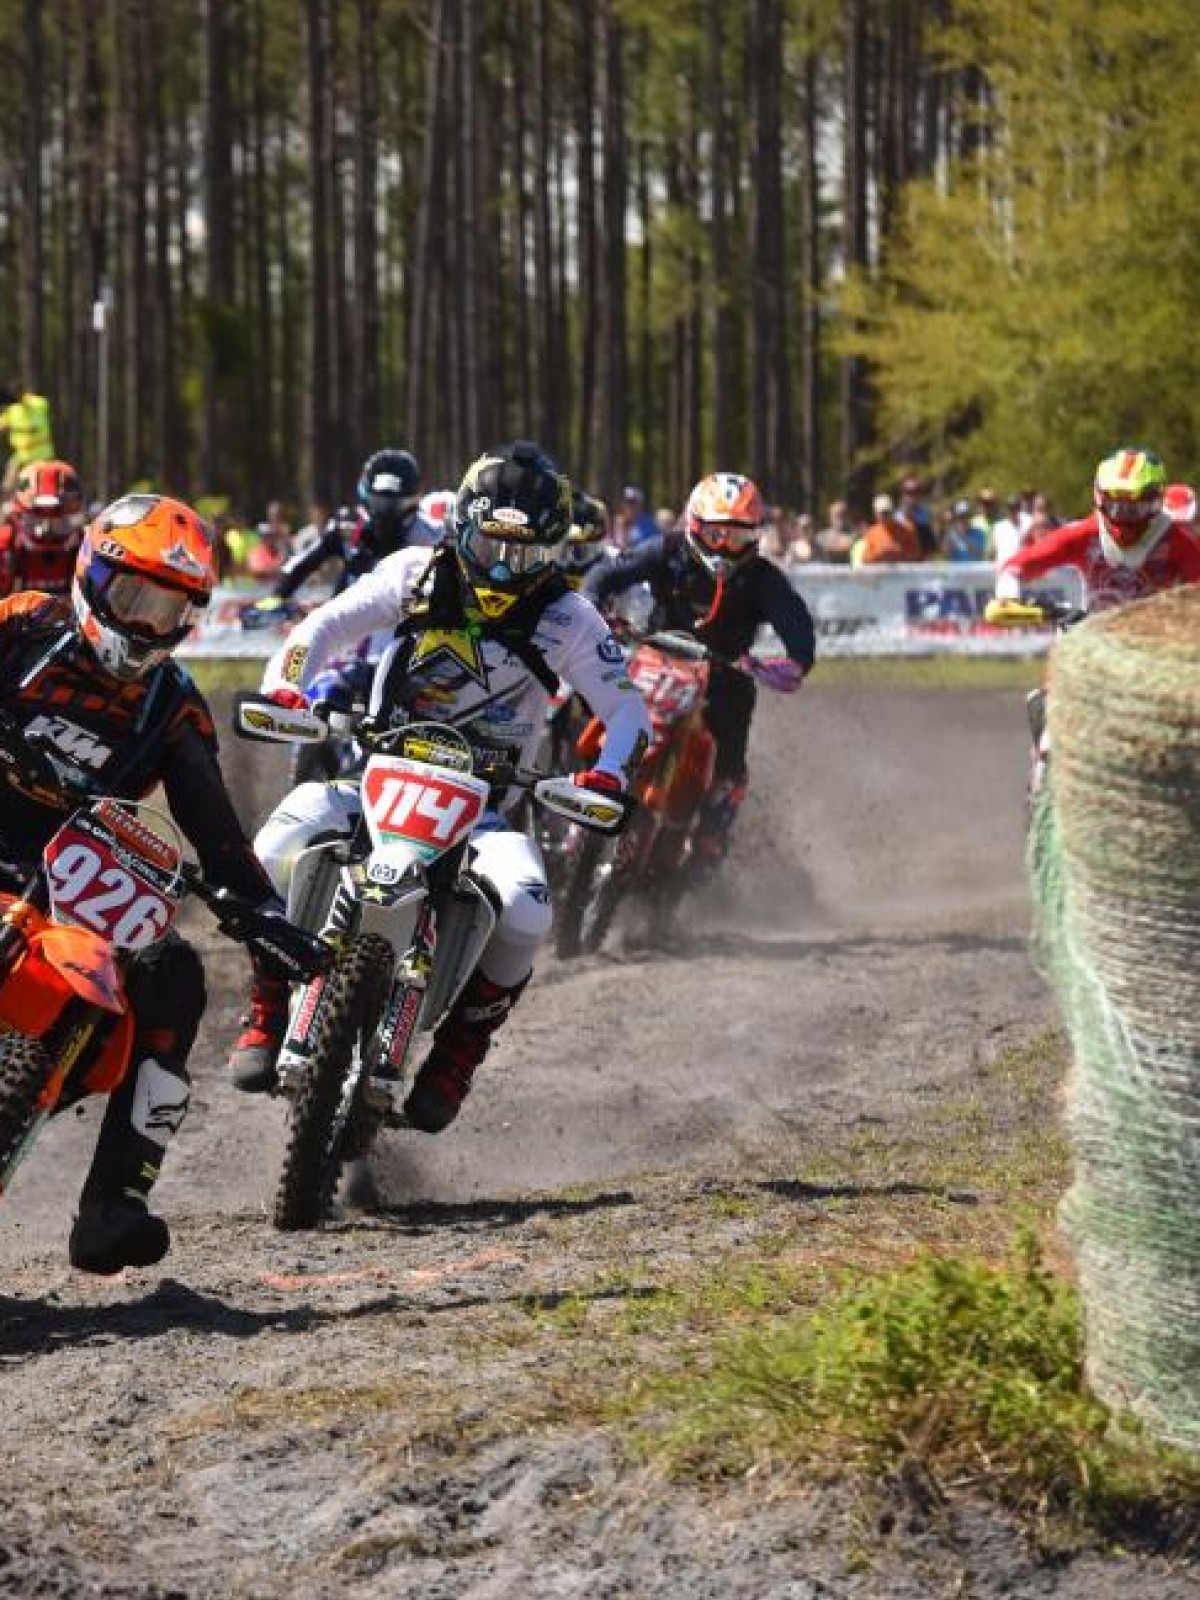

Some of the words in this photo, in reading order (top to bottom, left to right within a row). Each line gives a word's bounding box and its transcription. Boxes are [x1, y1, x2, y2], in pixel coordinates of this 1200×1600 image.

[23, 714, 112, 769] KTM
[372, 778, 469, 839] 114
[49, 843, 168, 950] 926
